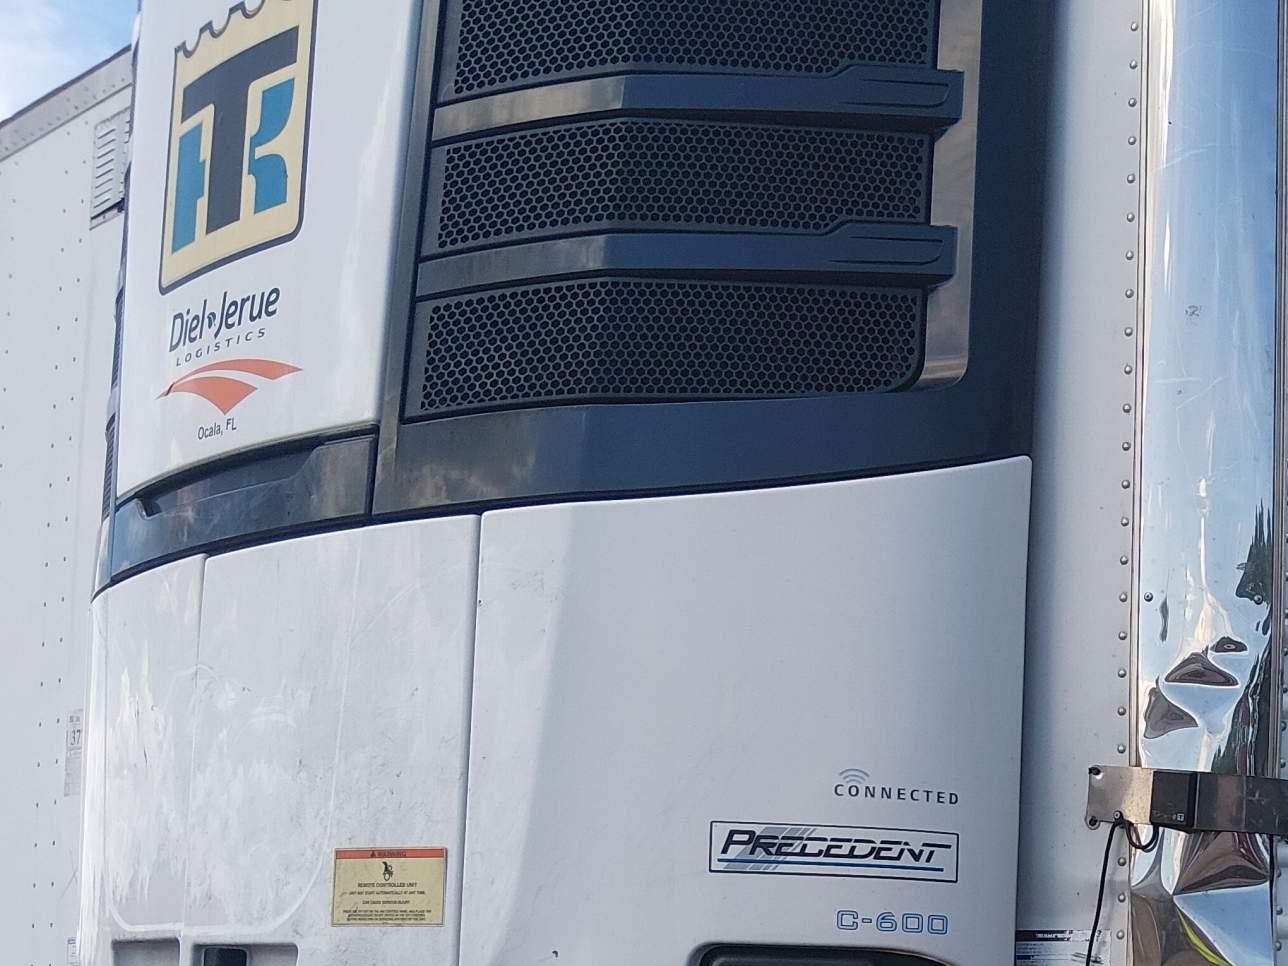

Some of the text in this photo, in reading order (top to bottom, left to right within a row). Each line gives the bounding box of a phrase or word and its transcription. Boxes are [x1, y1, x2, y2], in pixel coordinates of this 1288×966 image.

[176, 328, 265, 366] LOGISTICS
[198, 417, 237, 440] Ocala, FL
[834, 784, 959, 804] CONNECTED
[720, 829, 952, 863] PRECEDENT
[836, 910, 948, 935] C-600
